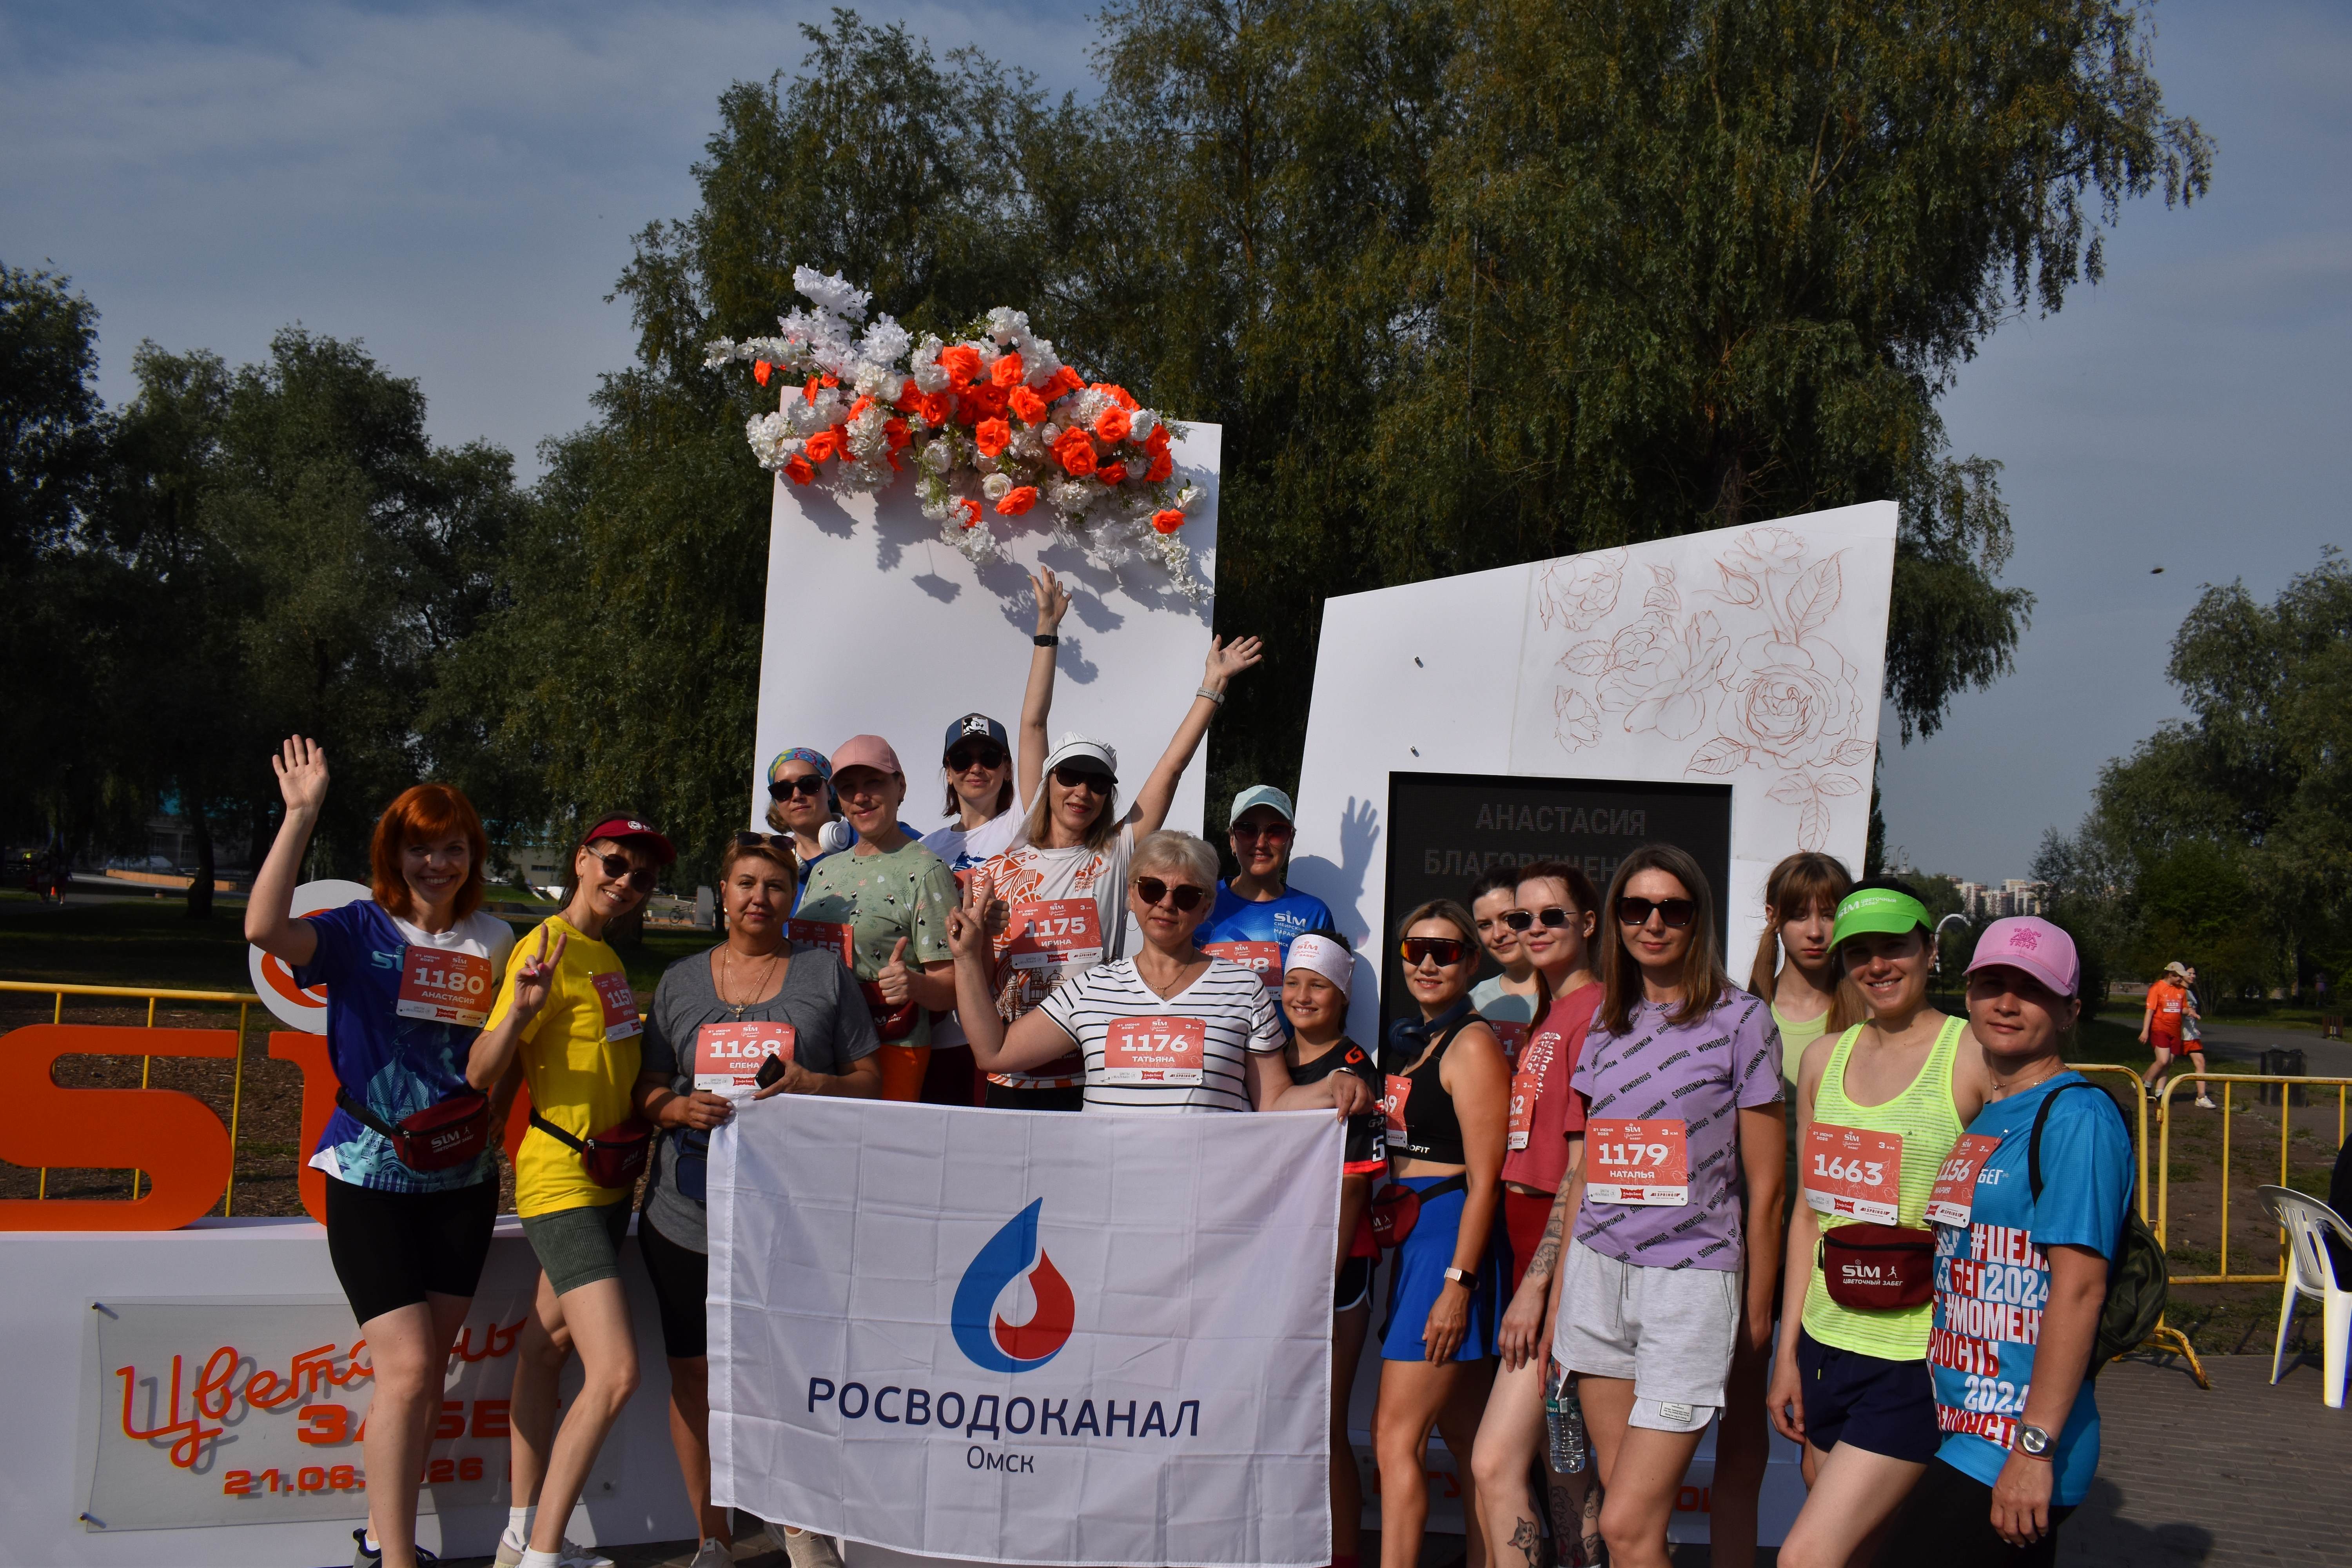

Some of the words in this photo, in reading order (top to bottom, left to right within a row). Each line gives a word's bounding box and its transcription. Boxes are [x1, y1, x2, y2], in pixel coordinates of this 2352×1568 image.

[1475, 803, 1646, 836] АНАСТАСИЯ
[1024, 917, 1085, 938] 1175
[1274, 922, 1305, 933] СИБИРСКИЙ
[1274, 928, 1299, 938] МАРАФ
[1229, 957, 1269, 973] 78
[414, 967, 484, 994] 1180
[421, 991, 475, 1004] АНАСТАСИЯ
[607, 989, 633, 1008] 1157
[710, 1040, 781, 1058] 1168
[1121, 1034, 1188, 1052] 1176
[1622, 1036, 1653, 1059] WONDROUS
[1696, 1035, 1730, 1053] WONDROUS
[1657, 1050, 1690, 1071] WONDROUS
[1744, 1049, 1767, 1080] WONDROUS
[1619, 1072, 1651, 1094] WONDROUS
[1672, 1078, 1707, 1099] WONDROUS
[1384, 1094, 1397, 1113] 69
[1372, 1135, 1385, 1162] 5
[1599, 1143, 1668, 1165] 1179
[1698, 1149, 1725, 1171] WONDROUS
[1814, 1154, 1883, 1186] 1663
[1936, 1160, 1974, 1181] 1156
[1672, 1211, 1706, 1233] WONDROUS
[1634, 1232, 1669, 1252] WONDROUS
[1945, 1293, 2043, 1345] #МОМЕН
[1926, 1327, 1999, 1377] РДОСТЬ
[808, 1376, 1200, 1441] РОСВОДОКАНАЛ
[298, 1399, 561, 1444] ЗБЕ
[1937, 1404, 2018, 1449] ЕДИНСТ
[224, 1457, 483, 1495] 21.06.26
